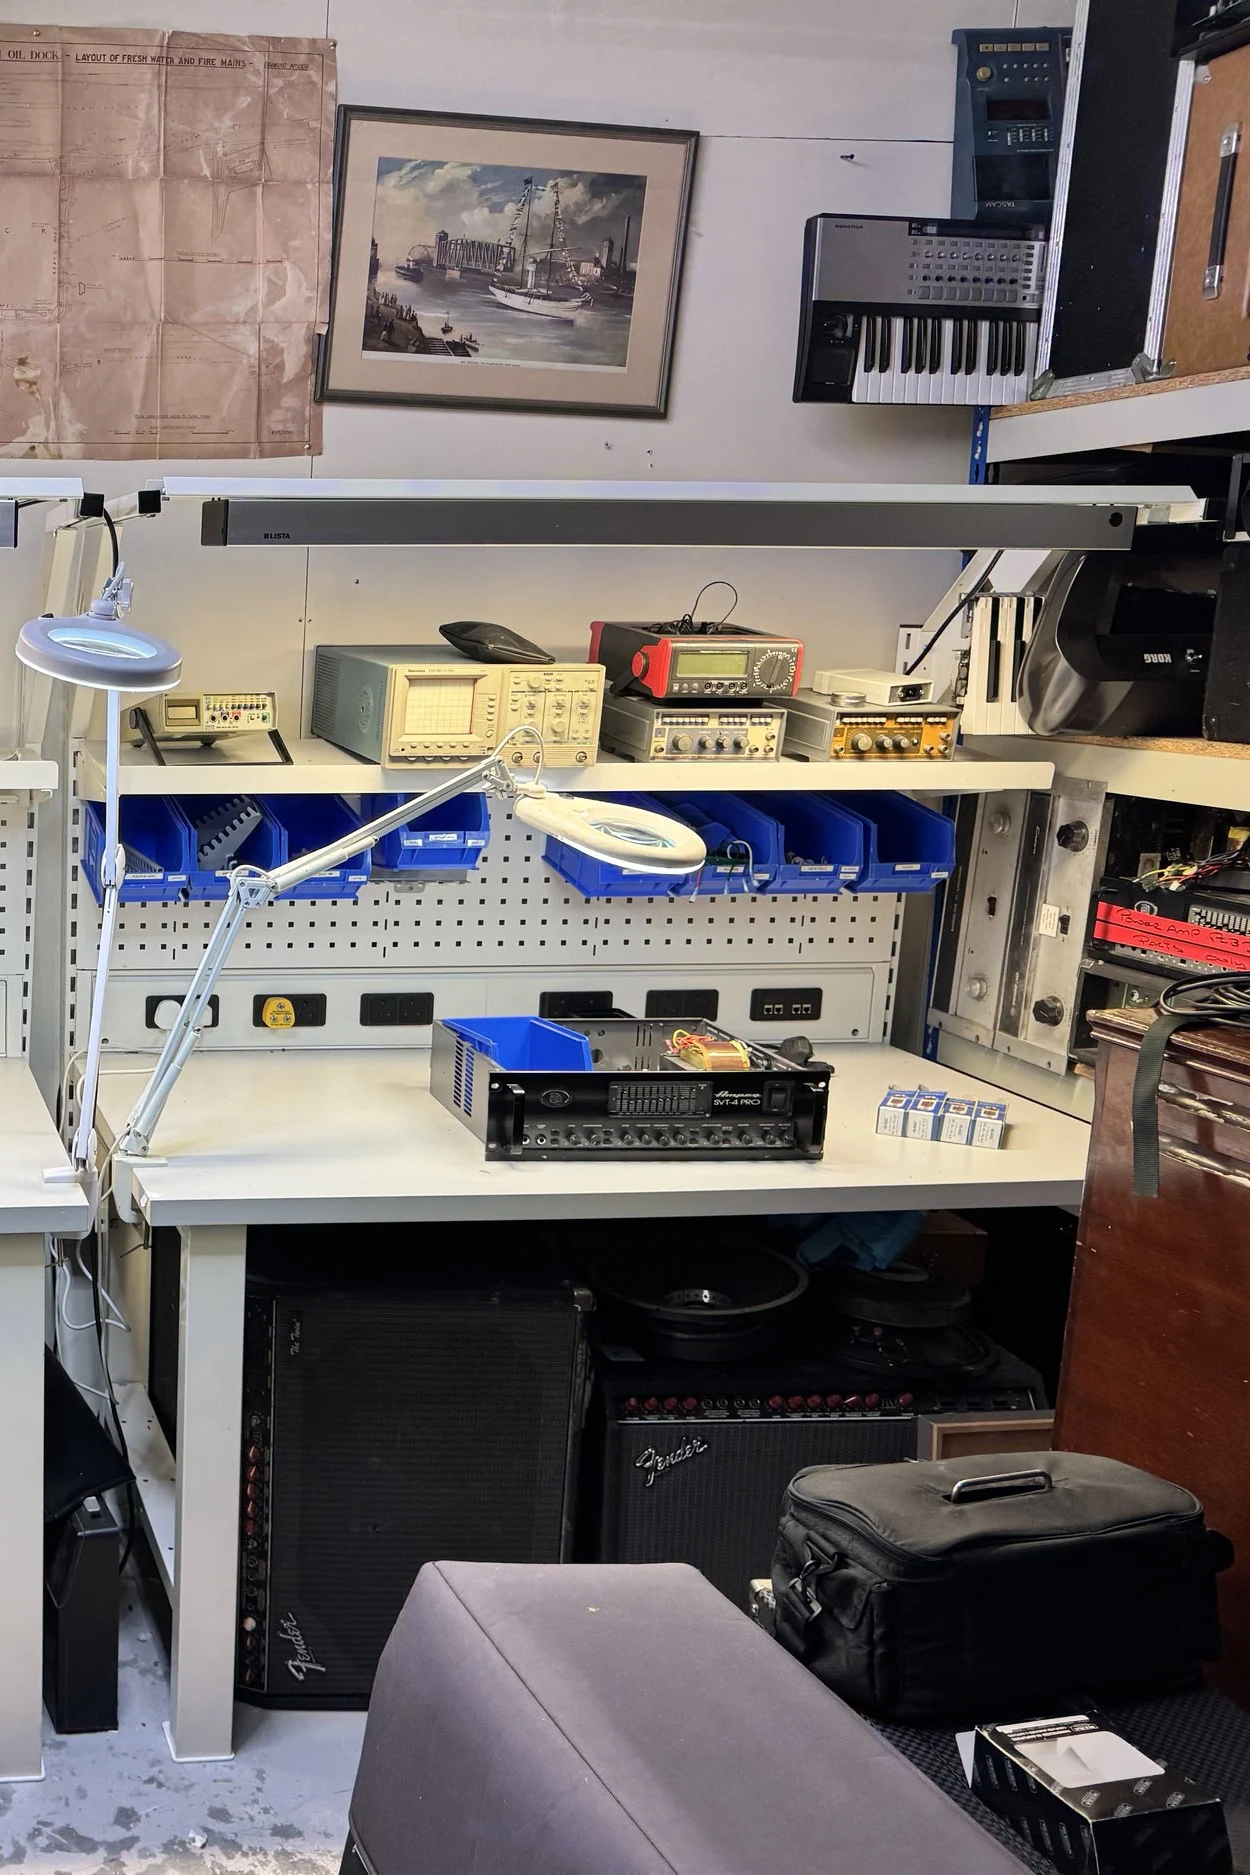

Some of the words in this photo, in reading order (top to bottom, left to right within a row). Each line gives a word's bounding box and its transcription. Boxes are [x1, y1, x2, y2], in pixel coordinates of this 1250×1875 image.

[8, 50, 25, 60] OIL
[75, 53, 107, 62] LAYOUT
[110, 53, 121, 62] OF
[121, 54, 148, 63] FRESH
[150, 55, 175, 64] WATER
[178, 56, 195, 65] AND
[198, 57, 216, 66] FIRE
[220, 58, 246, 67] MAINS
[1144, 653, 1172, 663] KORG
[635, 1436, 708, 1487] Fender
[276, 1612, 326, 1681] Fender
